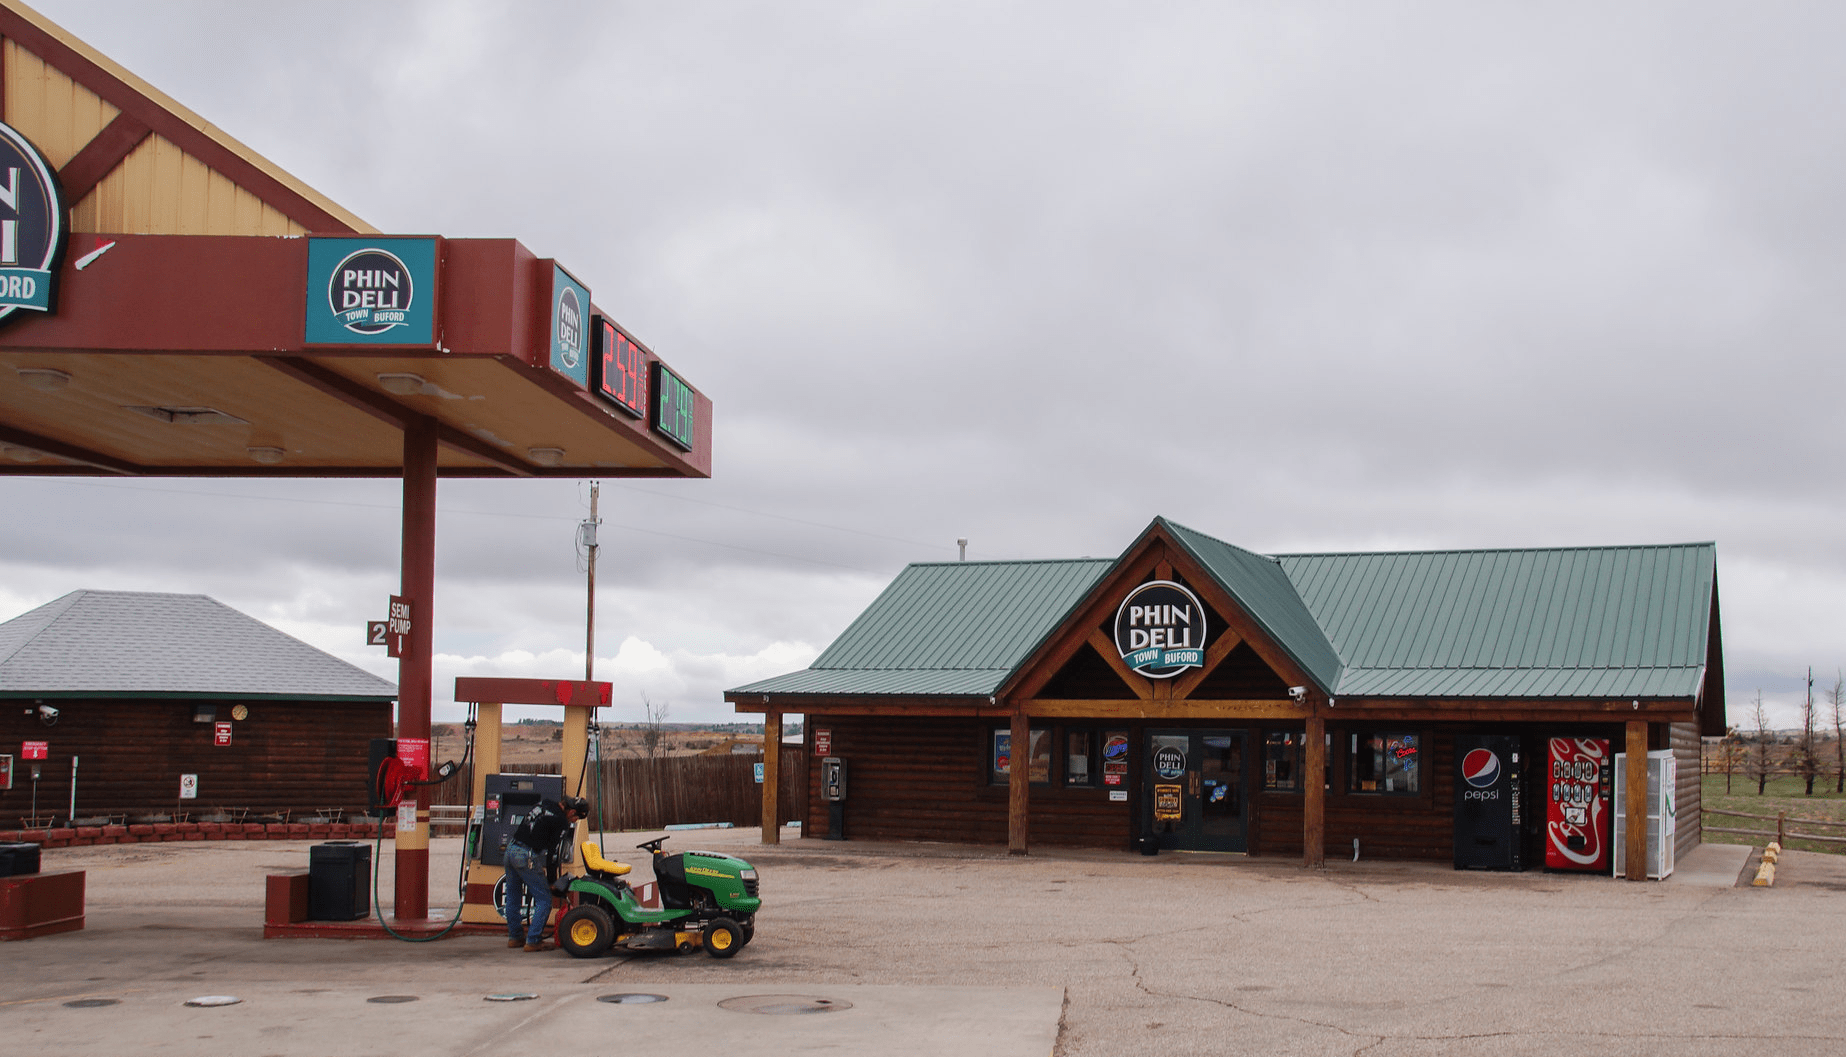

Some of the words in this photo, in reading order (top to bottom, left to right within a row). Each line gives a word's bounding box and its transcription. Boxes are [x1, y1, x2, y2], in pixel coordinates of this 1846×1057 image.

[343, 269, 399, 289] PHIN
[342, 290, 399, 309] DELI
[345, 308, 369, 322] TOWN
[374, 311, 405, 323] BUFORD
[561, 302, 579, 329] PHIN
[560, 321, 578, 348] DELI
[391, 602, 410, 620] SEMI
[1130, 604, 1191, 627] PHIN
[372, 623, 387, 644] 2
[389, 617, 412, 635] PUMP
[1130, 627, 1191, 650] DELI
[1133, 648, 1159, 665] TOWN
[1164, 651, 1198, 665] BUFORD
[1159, 752, 1181, 762] PHIN
[1159, 761, 1181, 770] DELI
[1464, 788, 1499, 801] pepsi
